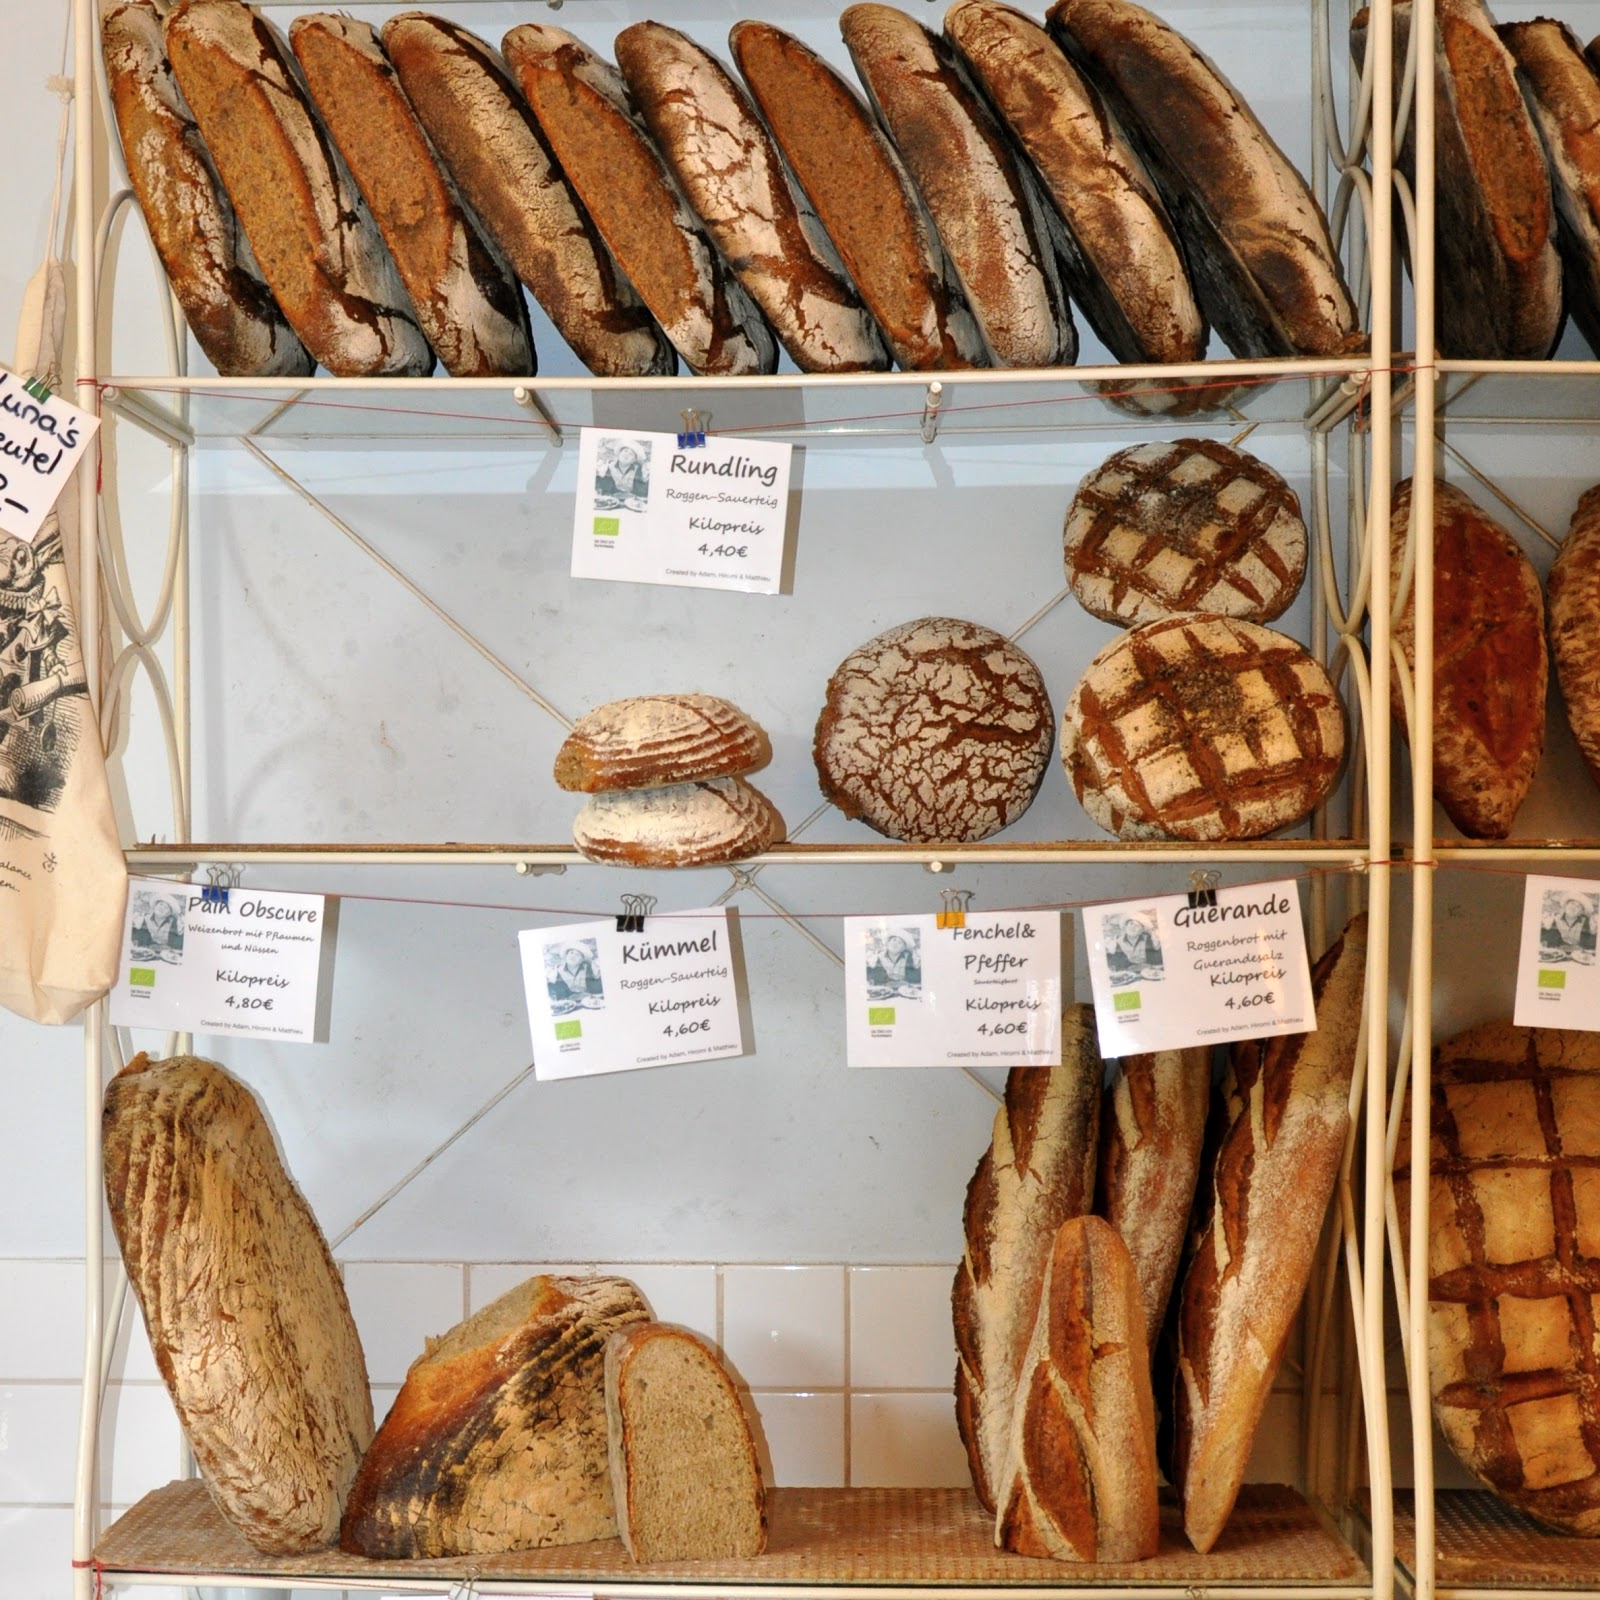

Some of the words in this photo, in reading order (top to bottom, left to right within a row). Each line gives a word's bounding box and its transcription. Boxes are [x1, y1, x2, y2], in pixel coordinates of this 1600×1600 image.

[670, 454, 778, 487] Rundling
[666, 489, 778, 508] Roggen-Sauerteig
[689, 517, 764, 536] Kilopreis
[698, 545, 747, 558] 4,40€
[665, 568, 689, 576] Created
[188, 896, 230, 914] Pain
[240, 900, 317, 923] Obscure
[188, 924, 242, 937] Weizenbrot
[246, 930, 264, 938] mit
[266, 930, 314, 943] Pflaumen
[1187, 934, 1260, 952] Roggenbrot
[1263, 930, 1288, 941] mit
[221, 943, 242, 951] und
[245, 944, 279, 954] Nüssen
[622, 930, 717, 964] Kümmel
[964, 954, 1028, 973] Pfeffer
[1194, 951, 1284, 971] Guerandesalz
[216, 969, 290, 989] Kilopreis
[620, 966, 728, 990] Roggen-Sauerteig
[1210, 966, 1287, 987] Kilopreis
[225, 995, 273, 1010] 4,80€
[648, 993, 721, 1015] Kilopreis
[966, 996, 1041, 1013] Kilopreis
[1224, 992, 1275, 1010] 4,60€
[662, 1019, 711, 1037] 4,60€
[977, 1023, 1028, 1037] 4,60€
[1197, 1027, 1221, 1035] Created
[637, 1055, 659, 1063] Created
